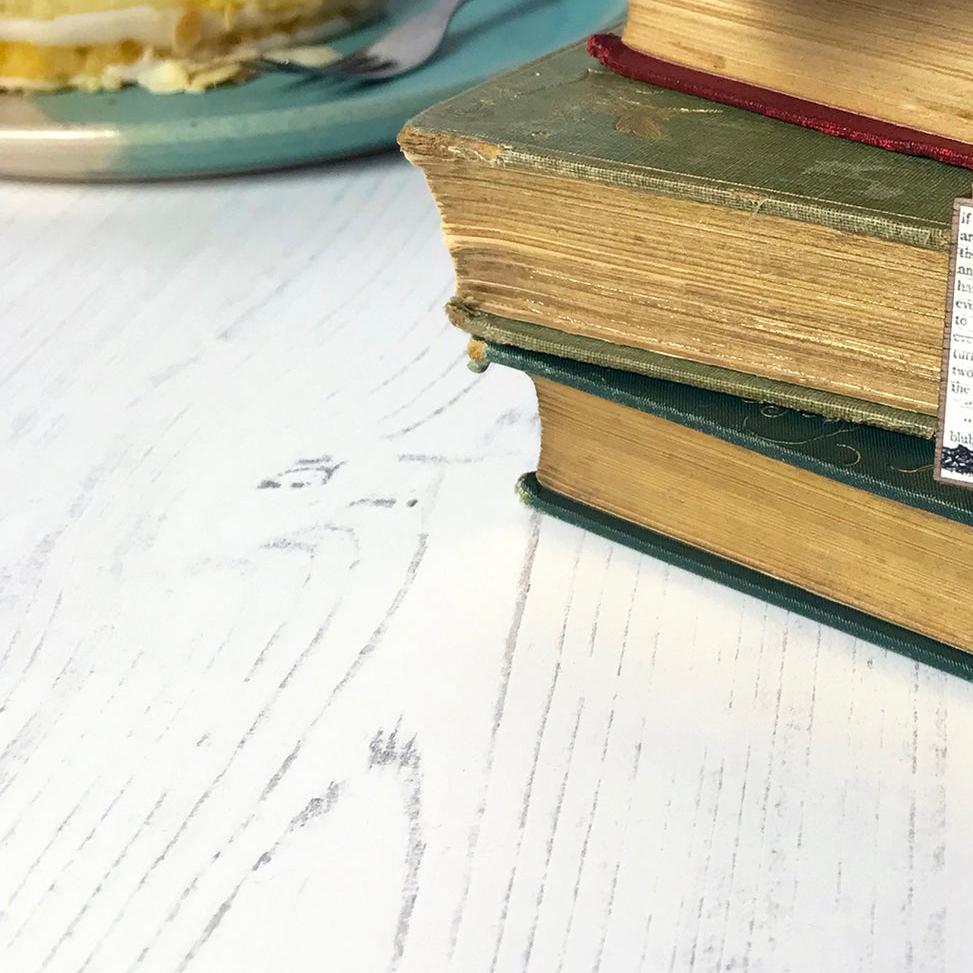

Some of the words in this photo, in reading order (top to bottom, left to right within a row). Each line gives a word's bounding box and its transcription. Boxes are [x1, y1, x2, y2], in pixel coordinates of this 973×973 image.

[961, 212, 971, 224] if
[954, 315, 967, 324] to
[951, 366, 973, 377] two
[950, 381, 970, 392] the
